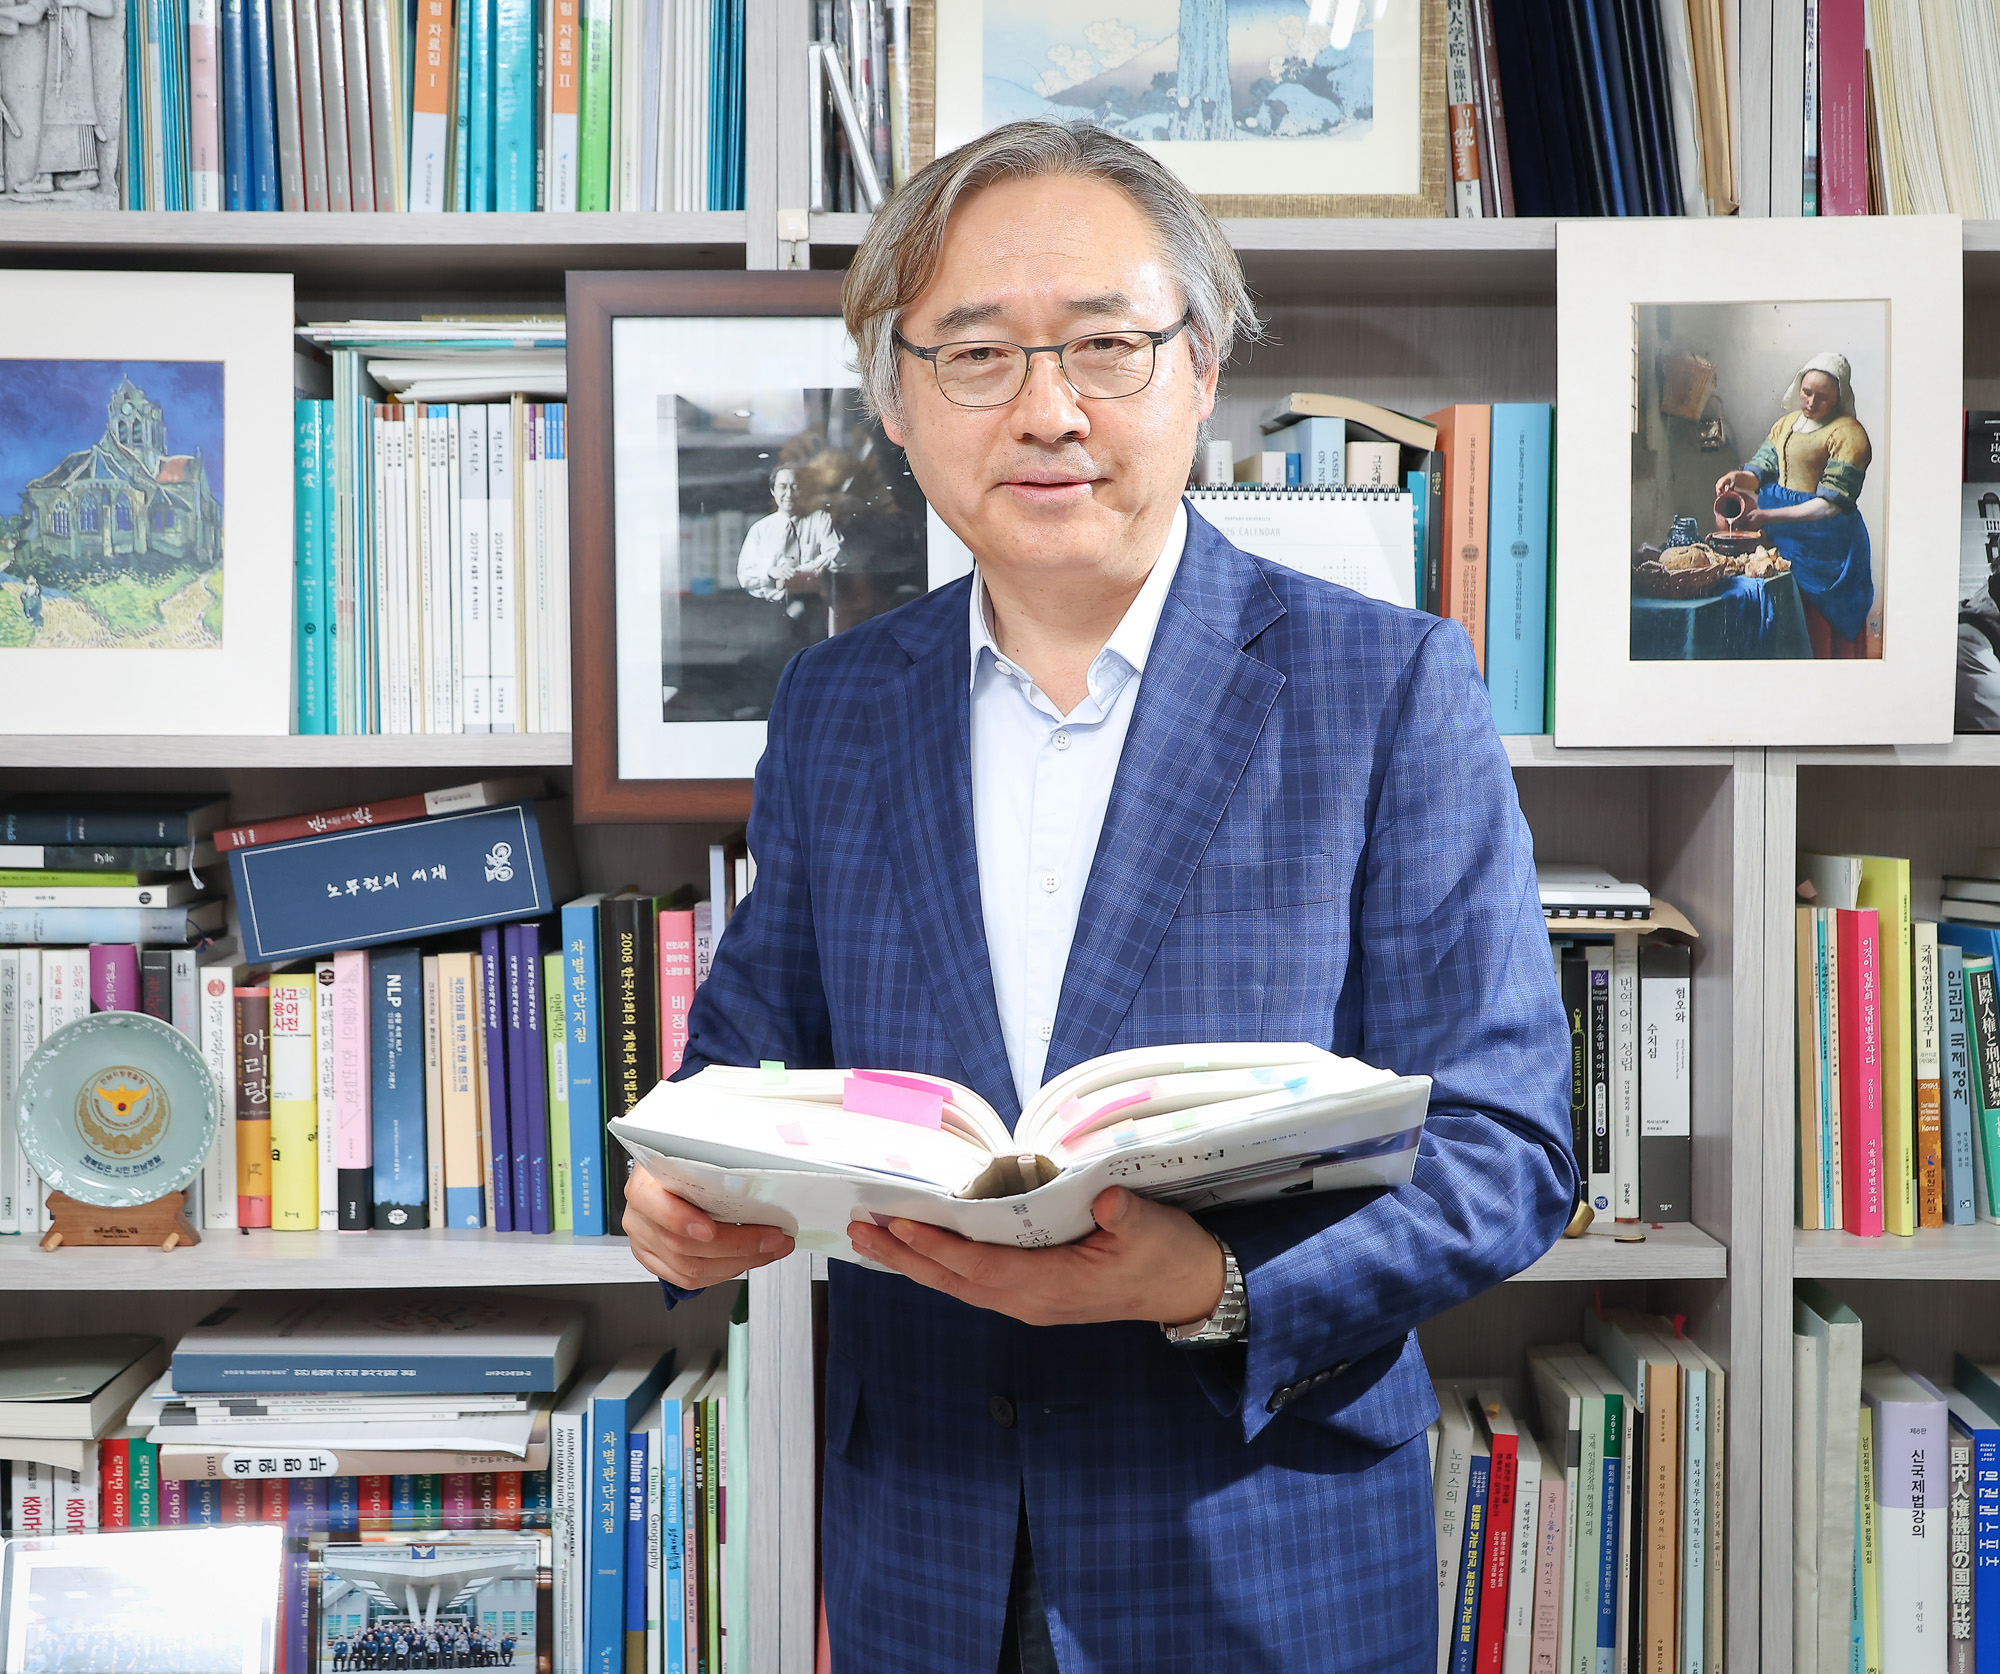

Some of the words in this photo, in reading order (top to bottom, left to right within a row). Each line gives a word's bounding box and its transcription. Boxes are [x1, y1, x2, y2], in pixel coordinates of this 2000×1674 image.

[428, 23, 442, 67] 자료집
[558, 23, 574, 67] 자료집
[1462, 107, 1475, 147] リーガル
[1453, 128, 1467, 176] クリニック
[1318, 451, 1325, 464] ON
[1331, 451, 1340, 478] CASES
[1238, 527, 1281, 537] CALENDAR
[93, 852, 115, 865] Pyle
[327, 871, 400, 899] 노무현의
[411, 863, 448, 882] 서재
[620, 932, 633, 963] 2008
[698, 937, 709, 984] 재심사
[1862, 937, 1872, 969] 이것이
[273, 988, 298, 1001] 사고
[386, 973, 402, 1008] NLP
[455, 976, 466, 1021] 국회의원을
[570, 939, 587, 1043] 차별판단지침
[621, 966, 636, 1025] 한국사회의
[1592, 988, 1608, 996] legal
[1863, 970, 1874, 1003] 일본의
[1920, 943, 1934, 1036] 국제인권법실무연구
[1947, 970, 1963, 1025] 인권과
[273, 1002, 298, 1016] 용어
[1619, 977, 1632, 1035] 번역어의
[1674, 987, 1686, 1023] 혐오와
[273, 1017, 298, 1031] 사전
[456, 1024, 467, 1042] 위한
[1595, 1004, 1605, 1051] 민사소송법
[1863, 1003, 1876, 1066] 당번변호사다
[457, 1045, 468, 1063] 인권
[622, 1029, 637, 1065] 개혁과
[1619, 1041, 1632, 1072] 성립
[1646, 1023, 1658, 1059] 수치심
[243, 1029, 271, 1104] 아리랑
[1595, 1052, 1606, 1080] 이야기
[1951, 1030, 1968, 1106] 국제정치
[1867, 1078, 1875, 1110] 2003
[1920, 1123, 1939, 1133] Korea
[115, 1166, 130, 1174] 시민
[1867, 1139, 1878, 1214] 서울지방변호사회
[582, 1168, 590, 1216] 국가인권위원회
[1925, 1168, 1937, 1216] 법원도서관
[556, 1428, 564, 1448] AND
[1588, 1433, 1596, 1447] 국제
[1862, 1437, 1868, 1450] 난민
[1909, 1427, 1927, 1435] 제8판
[108, 1455, 124, 1490] 로마인
[135, 1455, 151, 1490] 로마인
[207, 1456, 217, 1477] 2011
[233, 1456, 327, 1474] 회원명부
[556, 1449, 564, 1482] HUMAN
[566, 1428, 575, 1490] HARMONIOUS
[630, 1449, 644, 1494] China's
[601, 1430, 618, 1534] 차별판단지침
[650, 1466, 659, 1504] China's
[1445, 1448, 1463, 1505] 노모스의
[1978, 1470, 1999, 1515] 인권과
[112, 1493, 124, 1527] 이야기
[139, 1492, 151, 1529] 이야기
[630, 1495, 644, 1521] Path
[1585, 1494, 1594, 1519] 현재와
[1658, 1464, 1666, 1535] 검찰실무수습기록
[1693, 1458, 1701, 1536] 형사실무수습기록
[1911, 1449, 1926, 1539] 신국제법강의
[1442, 1509, 1456, 1538] 뜨락
[1470, 1504, 1482, 1530] 평화로
[1585, 1521, 1592, 1537] 미래
[1865, 1511, 1872, 1526] 절차
[648, 1513, 660, 1569] Geography
[1468, 1531, 1480, 1549] 가는
[1521, 1541, 1530, 1557] 삶의
[1866, 1549, 1872, 1564] 지침
[1951, 1446, 1971, 1640] 国内人権機関の国際比較
[1978, 1521, 2000, 1567] 스포츠
[1439, 1559, 1448, 1588] 양창수
[1467, 1550, 1478, 1567] 한국,
[1520, 1559, 1528, 1574] 기술
[1544, 1561, 1553, 1586] 마시고
[1464, 1568, 1477, 1605] 제국으로
[1544, 1589, 1552, 1598] 가
[1462, 1605, 1473, 1624] 가는
[1915, 1601, 1924, 1633] 정인섭
[1460, 1625, 1471, 1642] 일본
